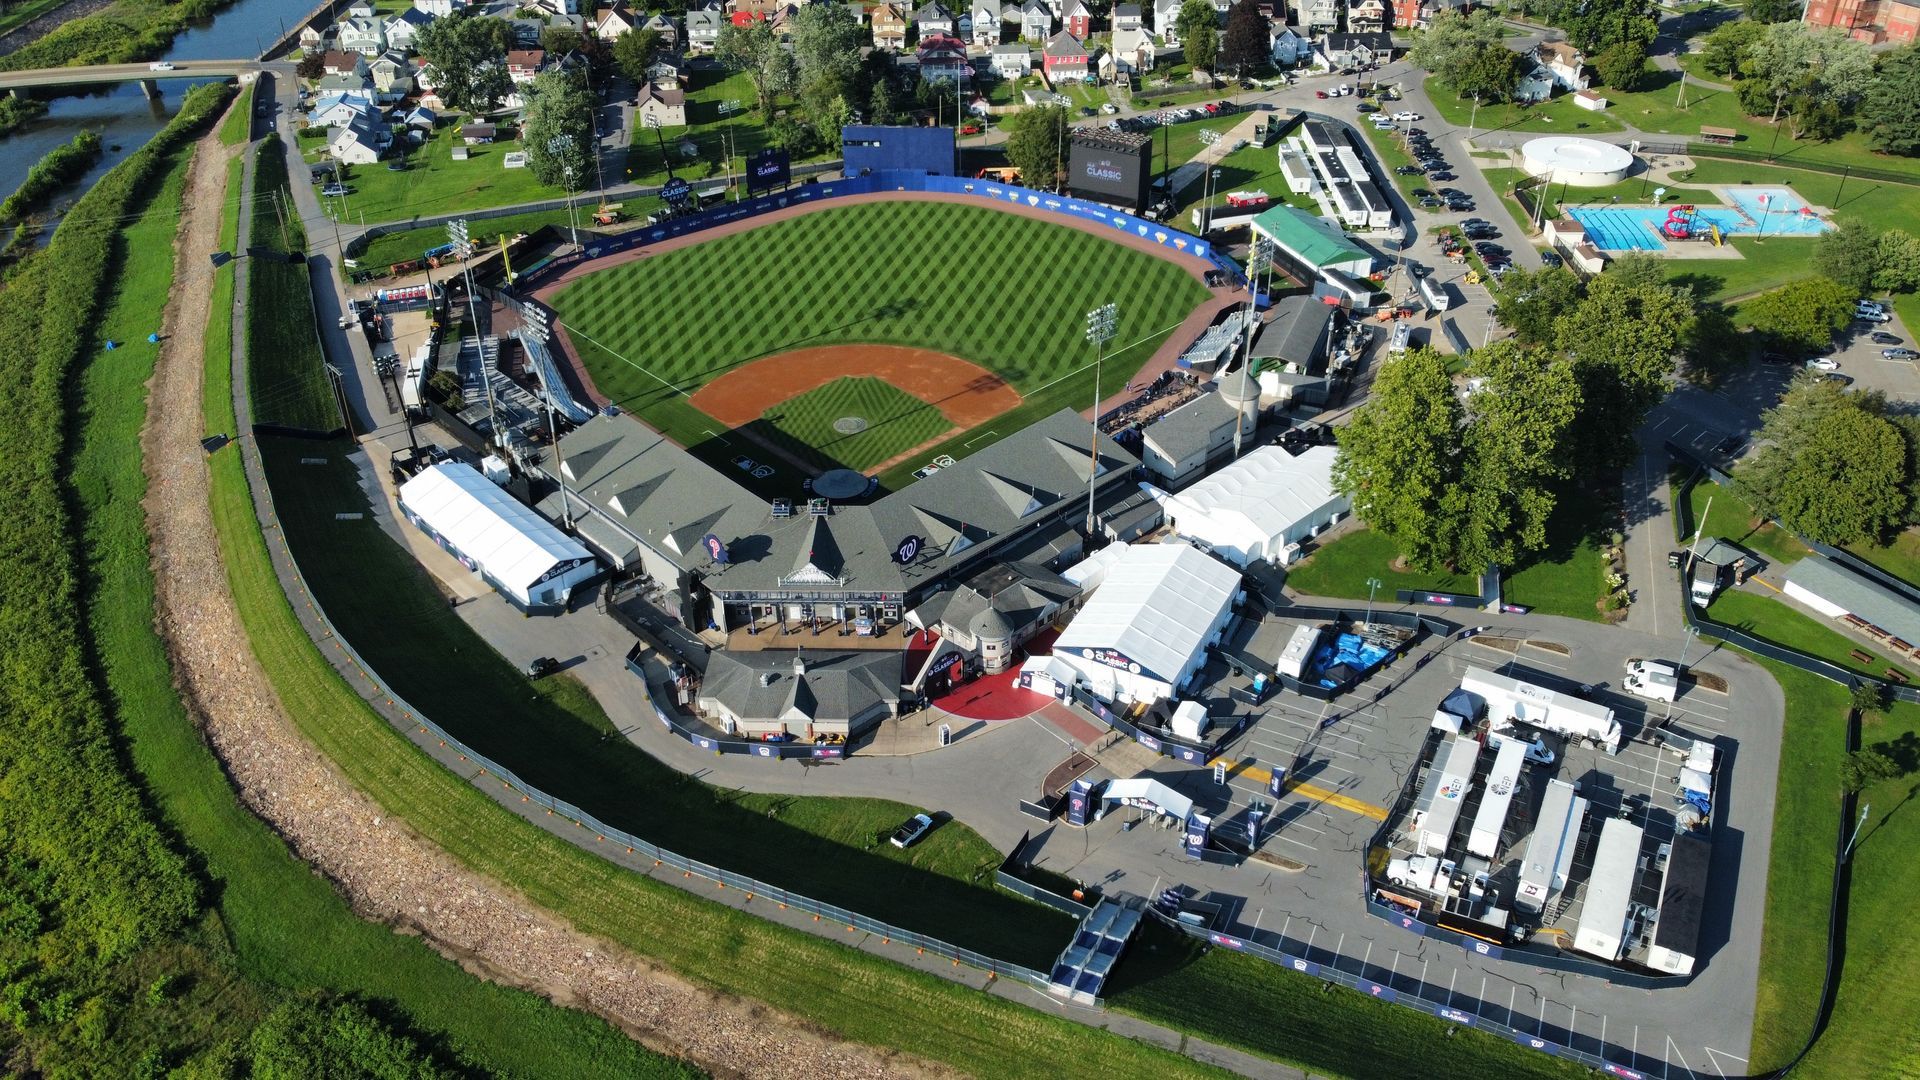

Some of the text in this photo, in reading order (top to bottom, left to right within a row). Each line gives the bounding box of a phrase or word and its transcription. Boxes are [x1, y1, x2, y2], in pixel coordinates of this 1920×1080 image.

[757, 165, 780, 177] CLASSIC
[1086, 166, 1122, 180] CLASSIC
[661, 184, 691, 198] CLASSIC
[900, 539, 917, 562] W
[550, 563, 573, 577] CLASSIC
[933, 657, 955, 673] CLASSIC
[1095, 653, 1128, 669] CLASSIC
